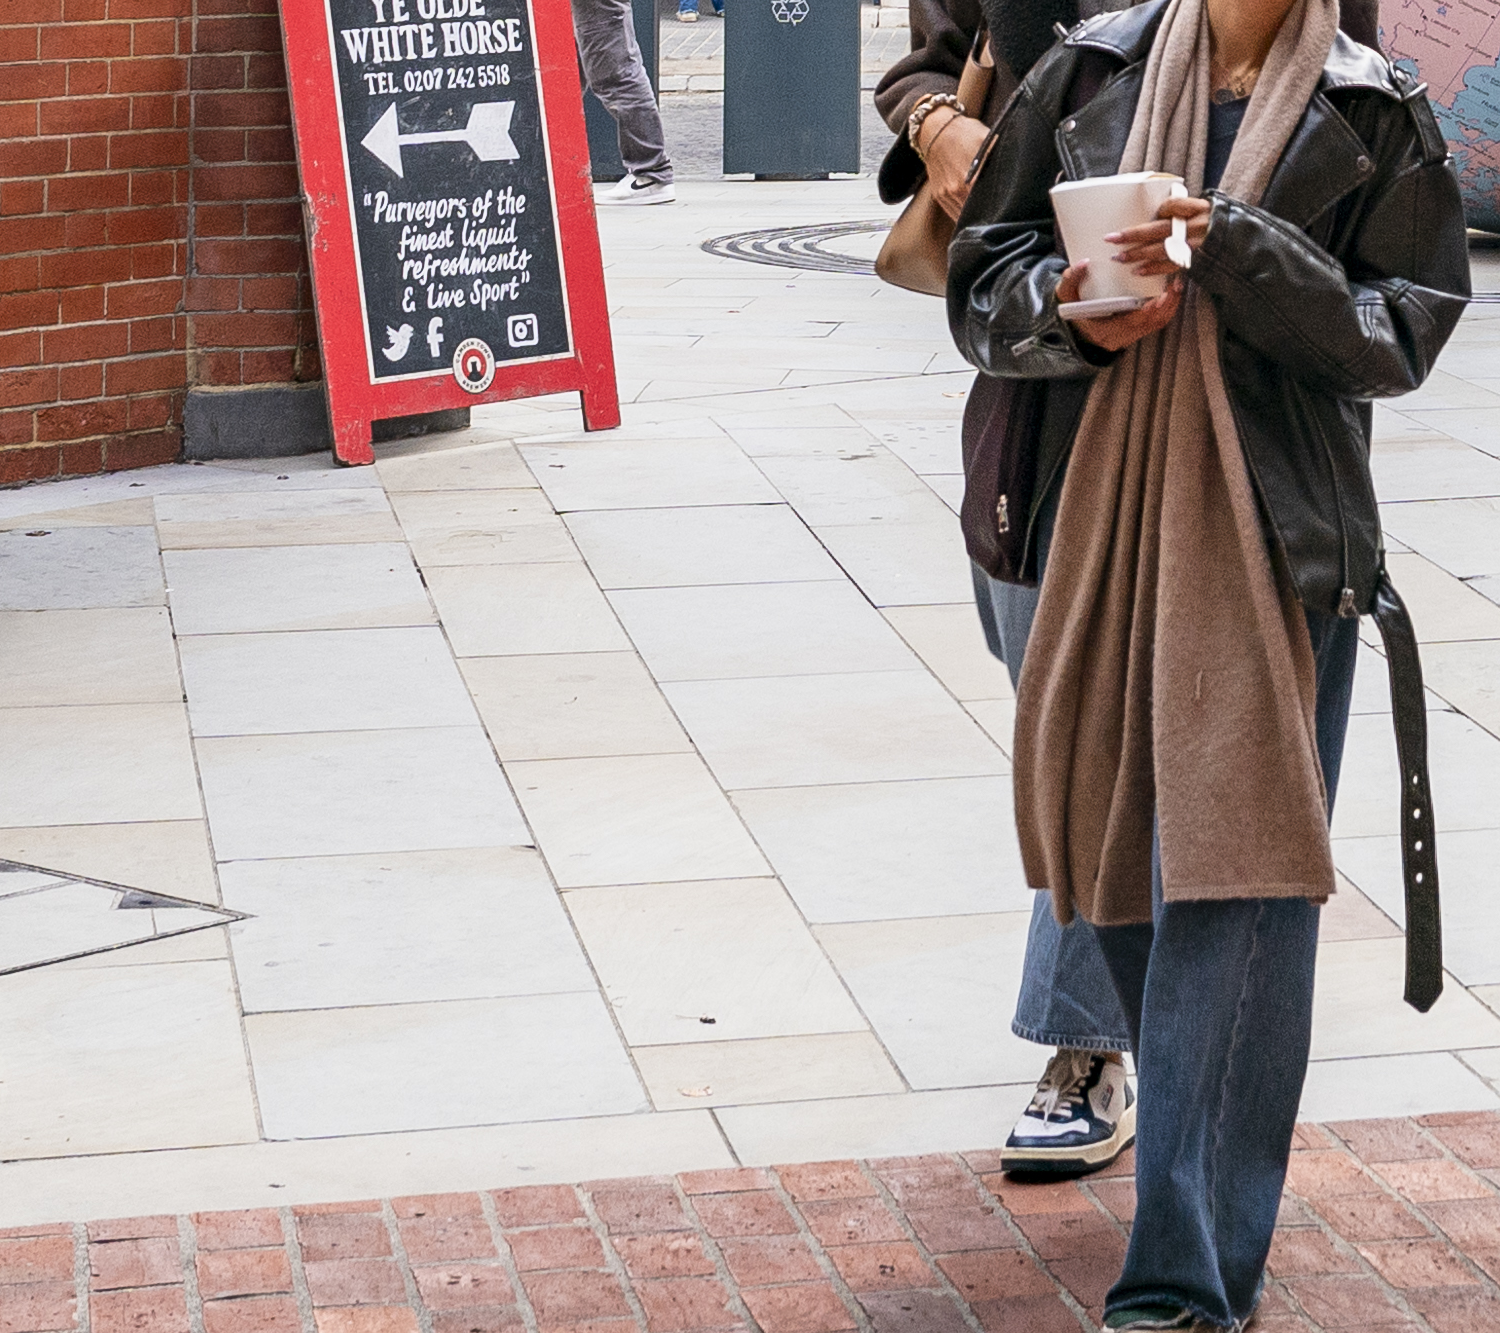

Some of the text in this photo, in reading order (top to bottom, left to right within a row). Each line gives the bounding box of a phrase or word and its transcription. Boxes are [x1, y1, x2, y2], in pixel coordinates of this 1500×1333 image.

[340, 18, 523, 64] WHITE HORSE
[363, 64, 511, 95] TEL. 0207 242 5518
[471, 188, 493, 224] of
[496, 185, 526, 216] the
[397, 217, 518, 260] finest liquid
[402, 244, 532, 286] refreshments
[402, 286, 416, 312] &
[456, 341, 491, 364] CAMDEN TOWN
[462, 377, 490, 390] BREWERY
